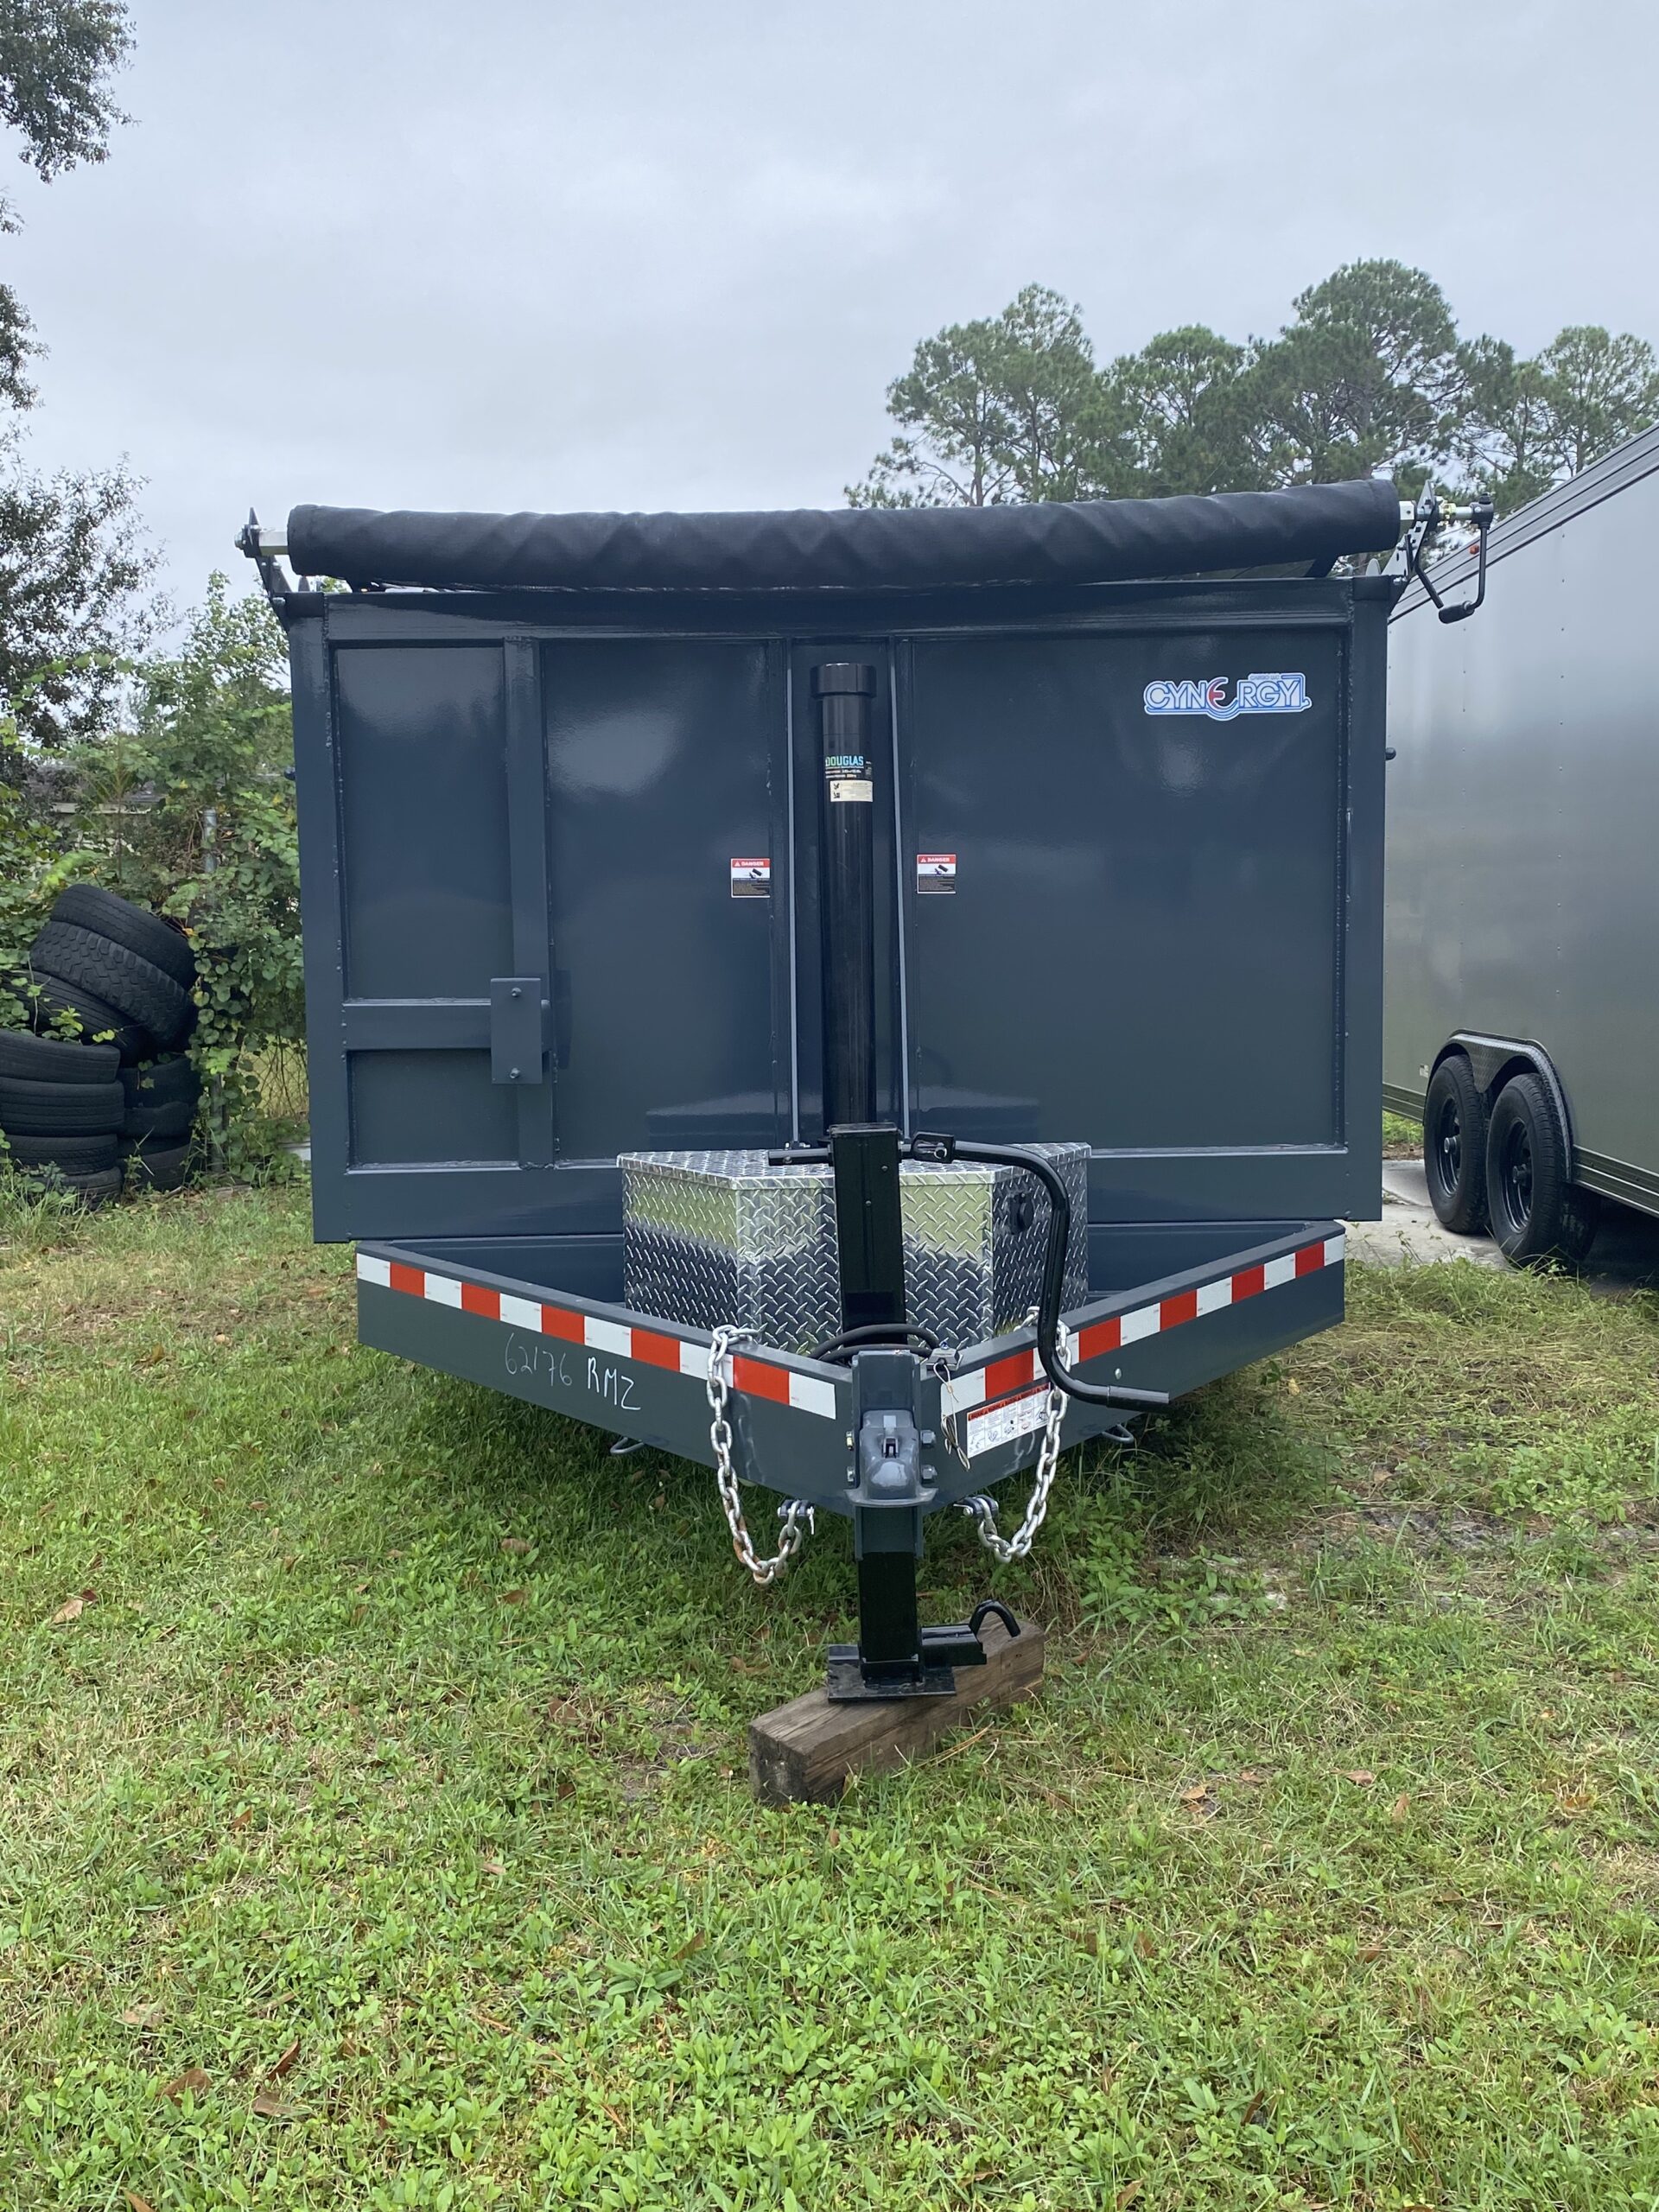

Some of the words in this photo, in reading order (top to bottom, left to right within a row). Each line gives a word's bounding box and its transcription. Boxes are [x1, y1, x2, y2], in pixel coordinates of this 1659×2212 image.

[1144, 675, 1305, 715] CYNERGY
[824, 755, 864, 766] DOUGLAS
[505, 1332, 573, 1387] 62176
